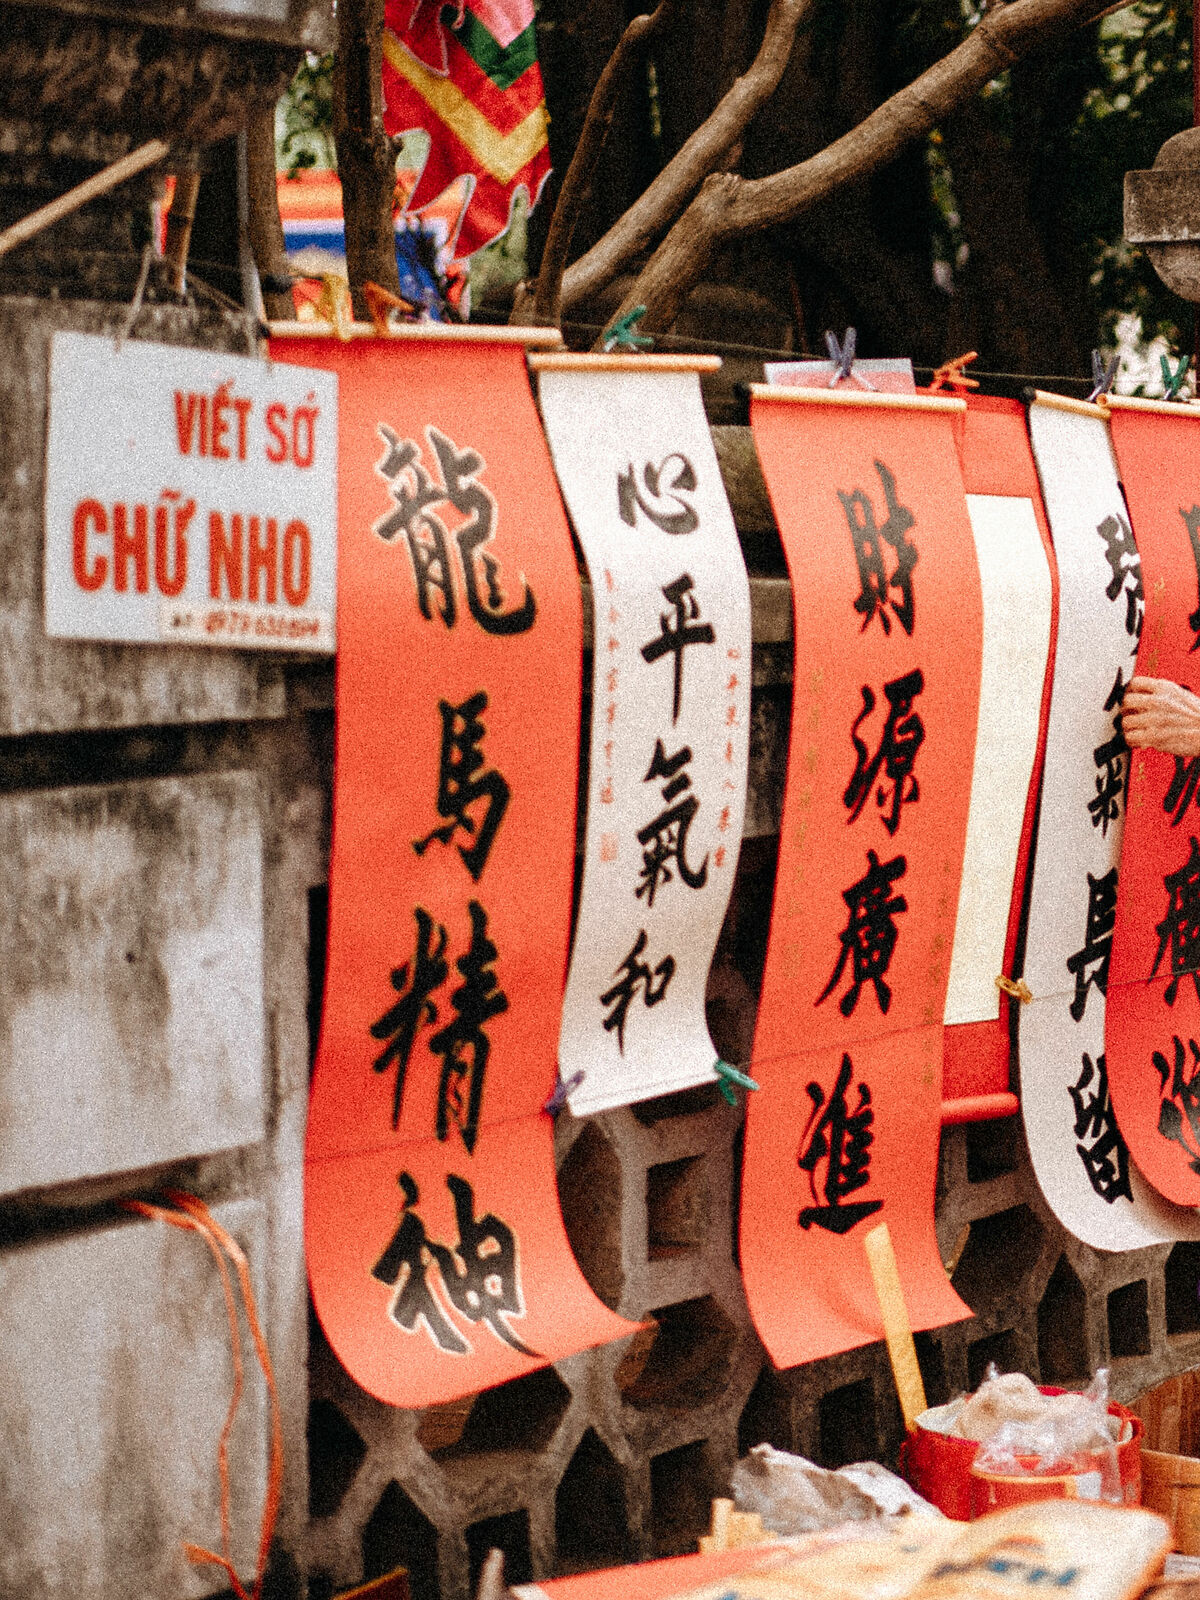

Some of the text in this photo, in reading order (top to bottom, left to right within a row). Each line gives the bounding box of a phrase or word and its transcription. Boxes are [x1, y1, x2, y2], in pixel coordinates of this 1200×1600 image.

[72, 488, 311, 607] CHỮ NHO
[174, 378, 252, 462] VIẾT
[370, 423, 547, 1358] 龍馬精神
[600, 452, 716, 1055] 心平氣和
[797, 458, 925, 1235] 財源廣進
